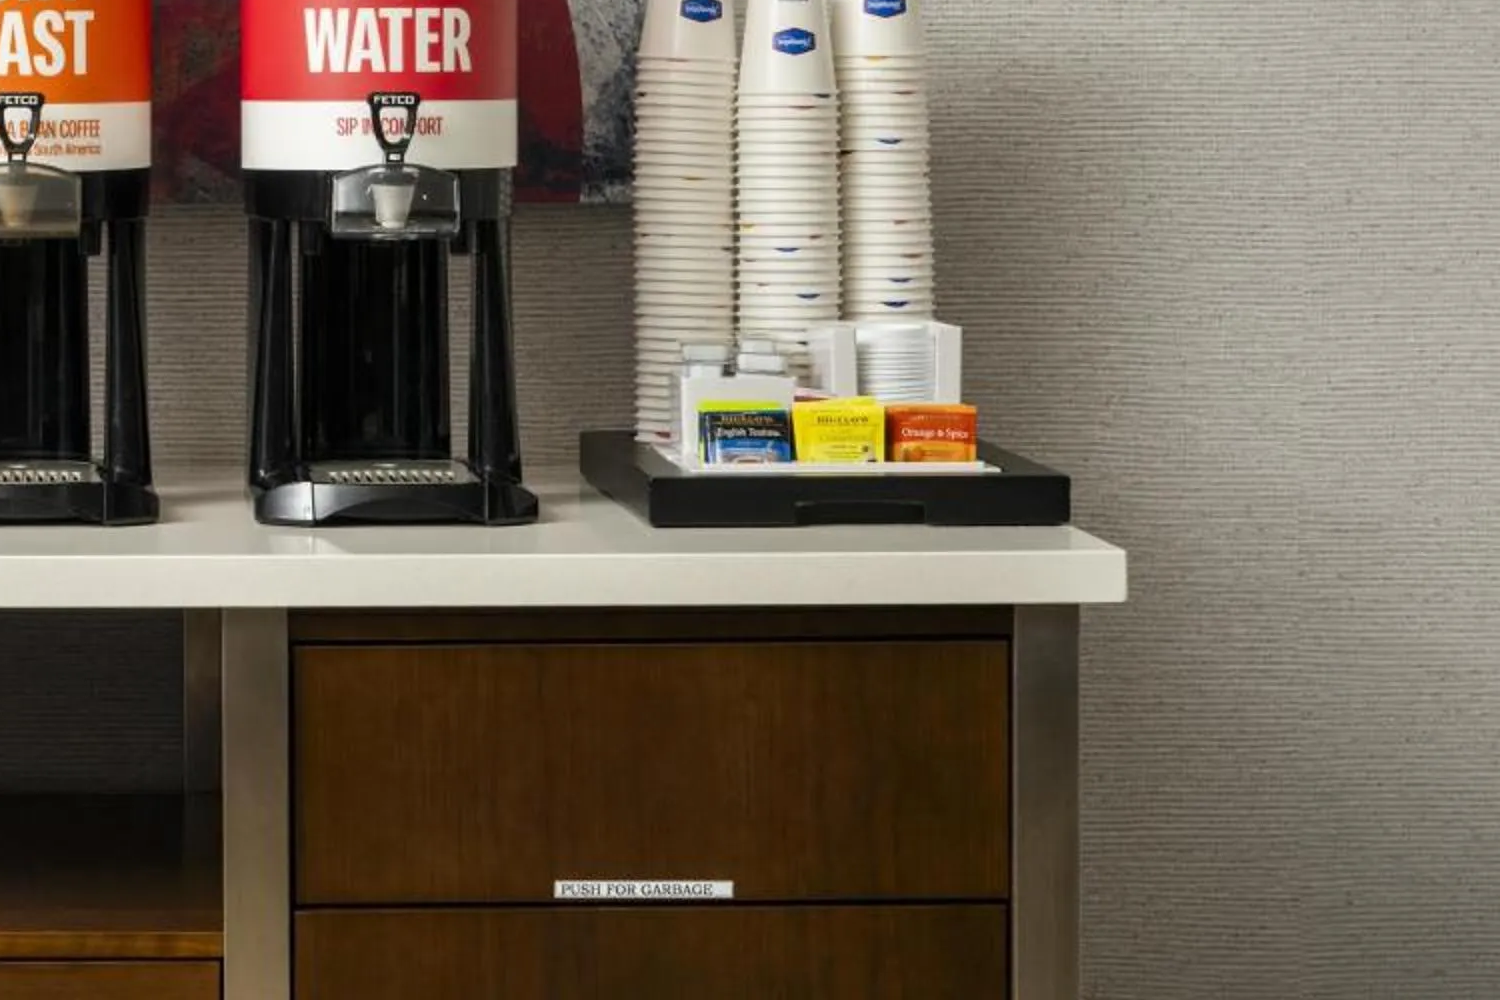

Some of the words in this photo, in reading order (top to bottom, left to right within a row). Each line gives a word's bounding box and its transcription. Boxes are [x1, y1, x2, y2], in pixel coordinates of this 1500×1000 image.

[302, 6, 473, 74] WATER
[372, 94, 416, 106] FETCO
[19, 119, 57, 138] BAN
[59, 119, 102, 138] COFFEE
[336, 116, 358, 137] SIP
[382, 116, 443, 136] COORT
[900, 427, 935, 440] Orange
[944, 427, 969, 441] Spice
[561, 882, 601, 897] PUSH
[606, 882, 636, 897] FOR
[640, 882, 714, 897] GARBAGE
